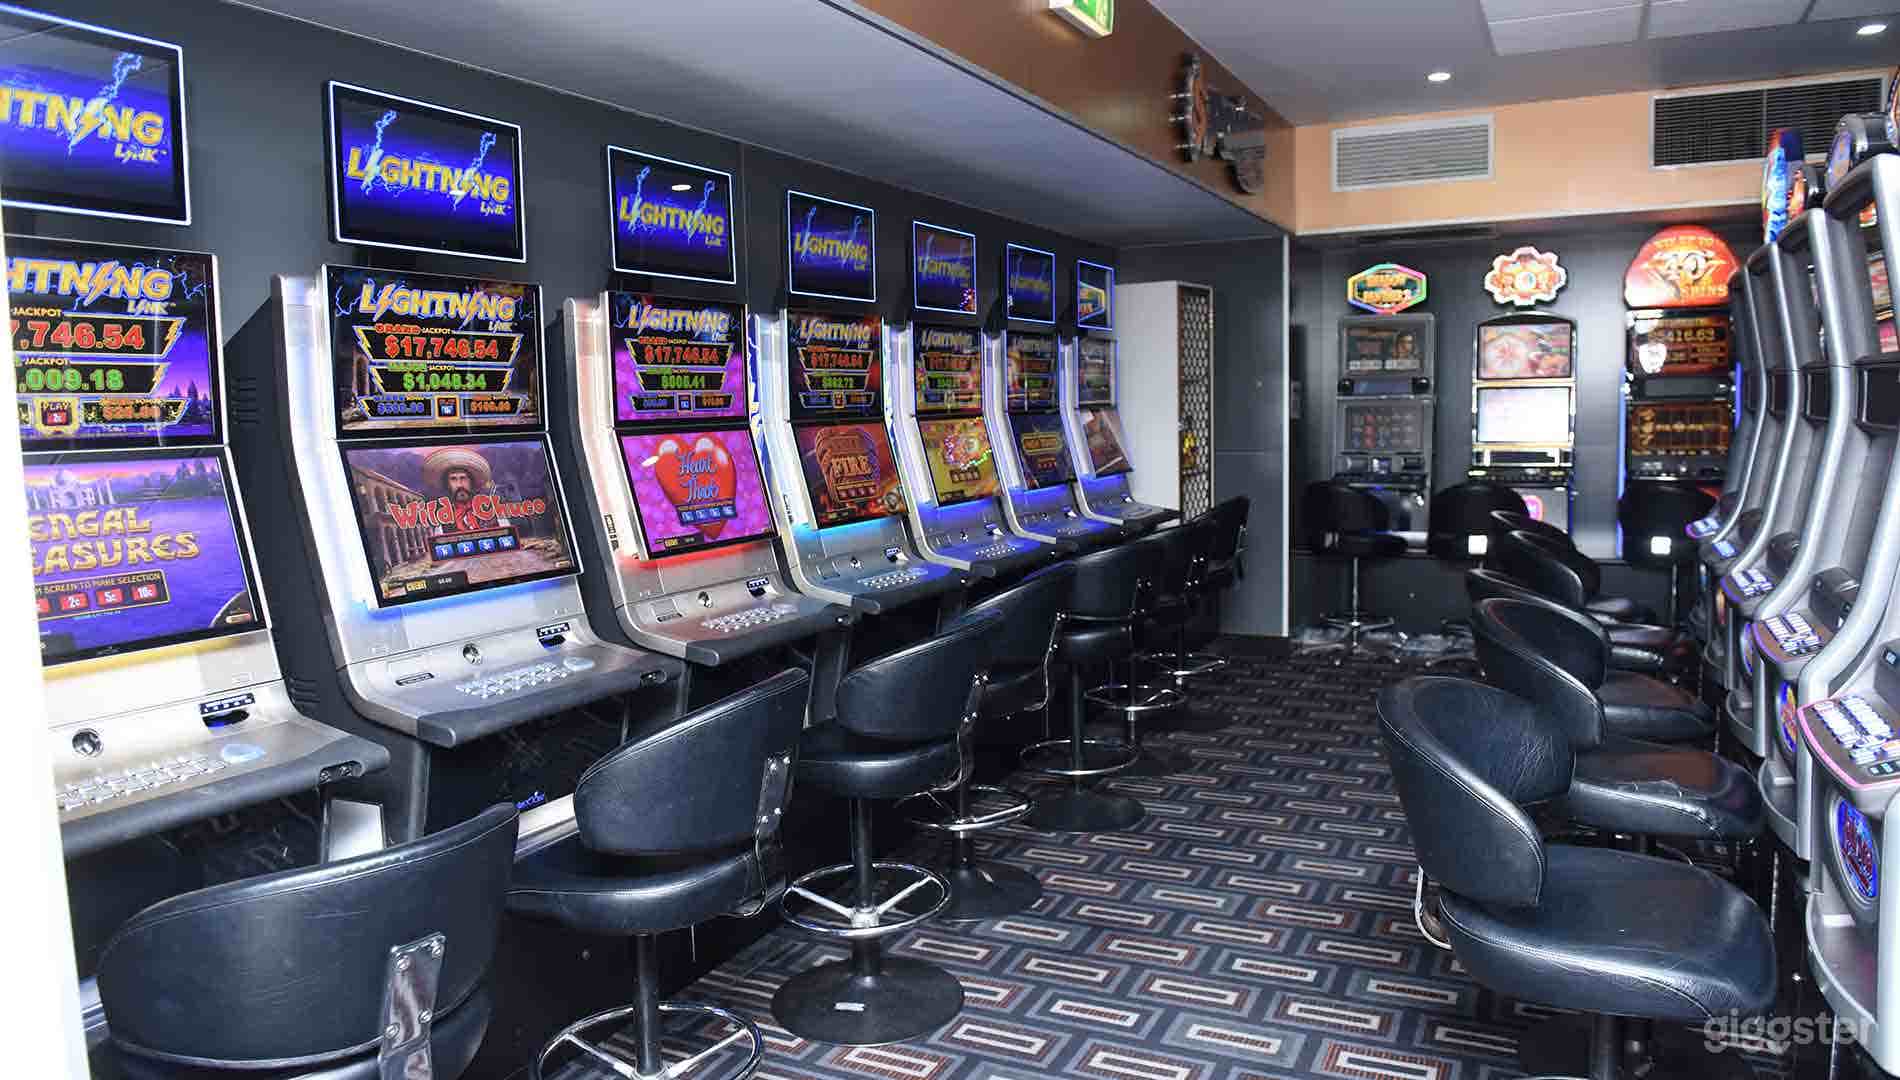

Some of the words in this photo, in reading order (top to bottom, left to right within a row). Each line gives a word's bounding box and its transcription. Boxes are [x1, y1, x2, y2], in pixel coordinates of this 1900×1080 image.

[347, 147, 510, 205] LIGHTNING
[620, 196, 725, 238] LIGHTNING
[14, 307, 62, 317] JACKPOT
[359, 284, 515, 321] LIGHTNING
[628, 304, 730, 334] LIGHTNING
[384, 335, 499, 359] $17,746.54
[801, 320, 870, 343] LIGHTNING
[29, 507, 152, 542] ENGAL
[390, 497, 455, 529] Wild
[472, 495, 546, 521] Chuco
